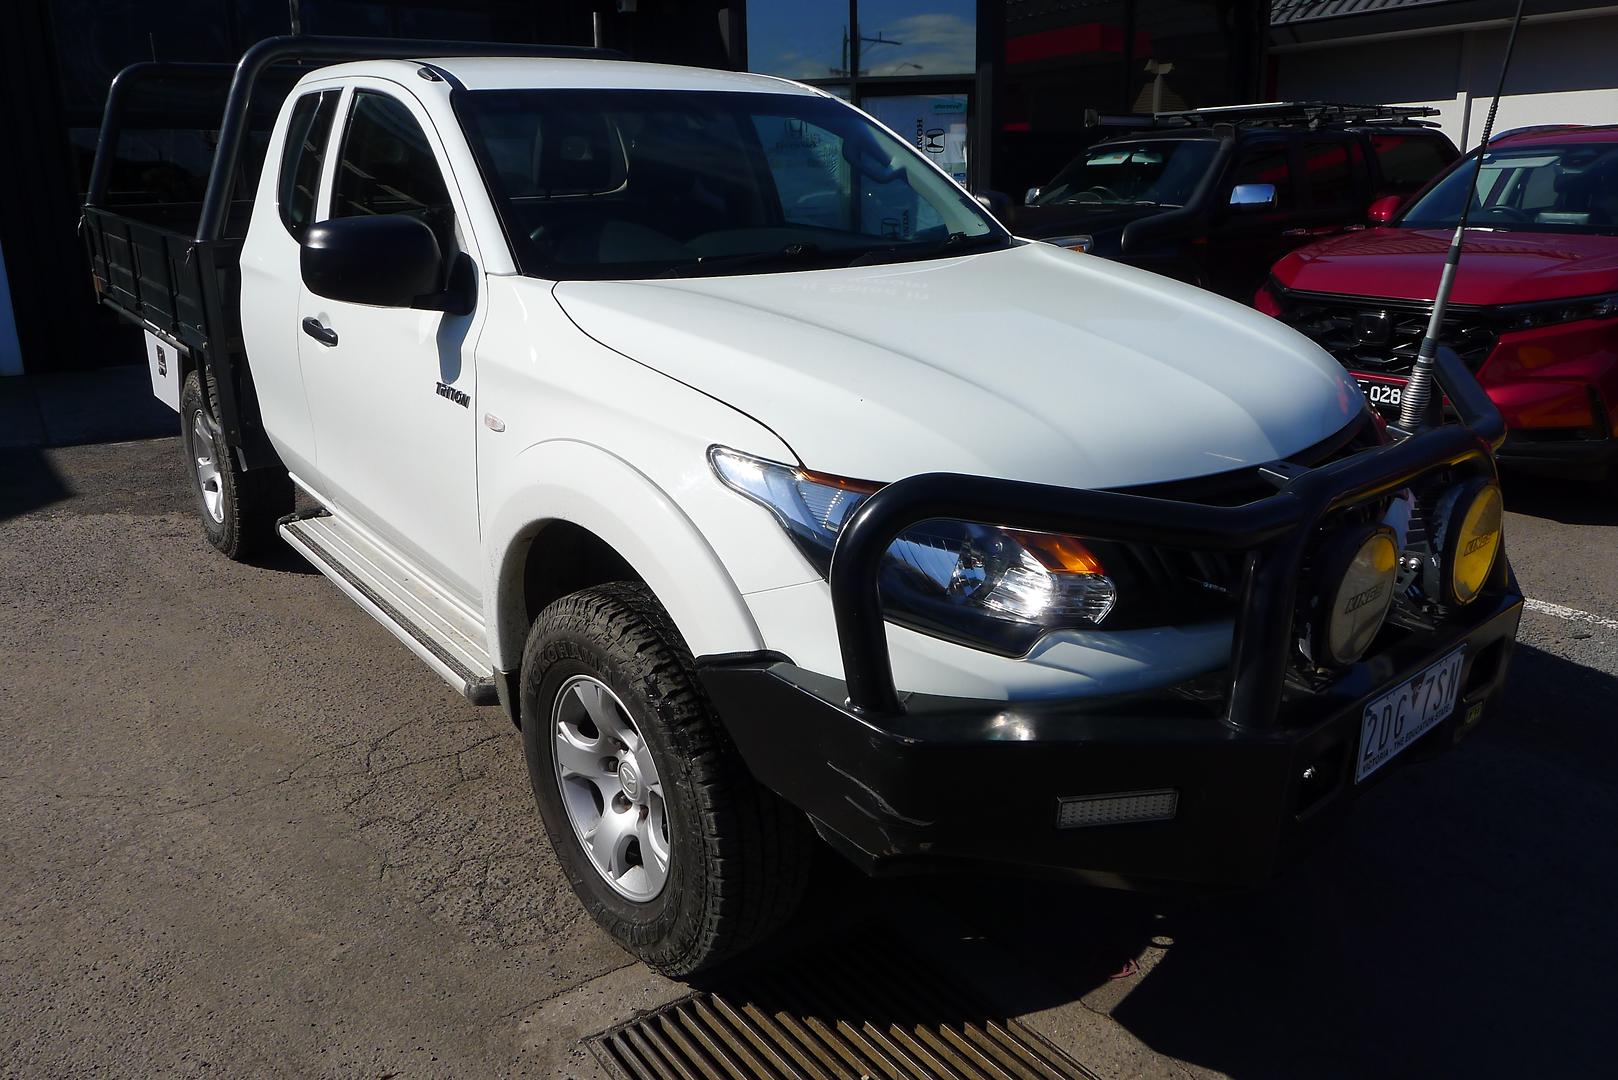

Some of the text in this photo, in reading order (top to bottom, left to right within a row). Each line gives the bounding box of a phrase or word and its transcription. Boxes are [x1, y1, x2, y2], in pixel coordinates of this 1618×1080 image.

[436, 381, 471, 409] TRITON
[1370, 385, 1401, 404] 028
[1363, 659, 1460, 761] 2DG 7SN
[1363, 749, 1389, 773] VICTORIA
